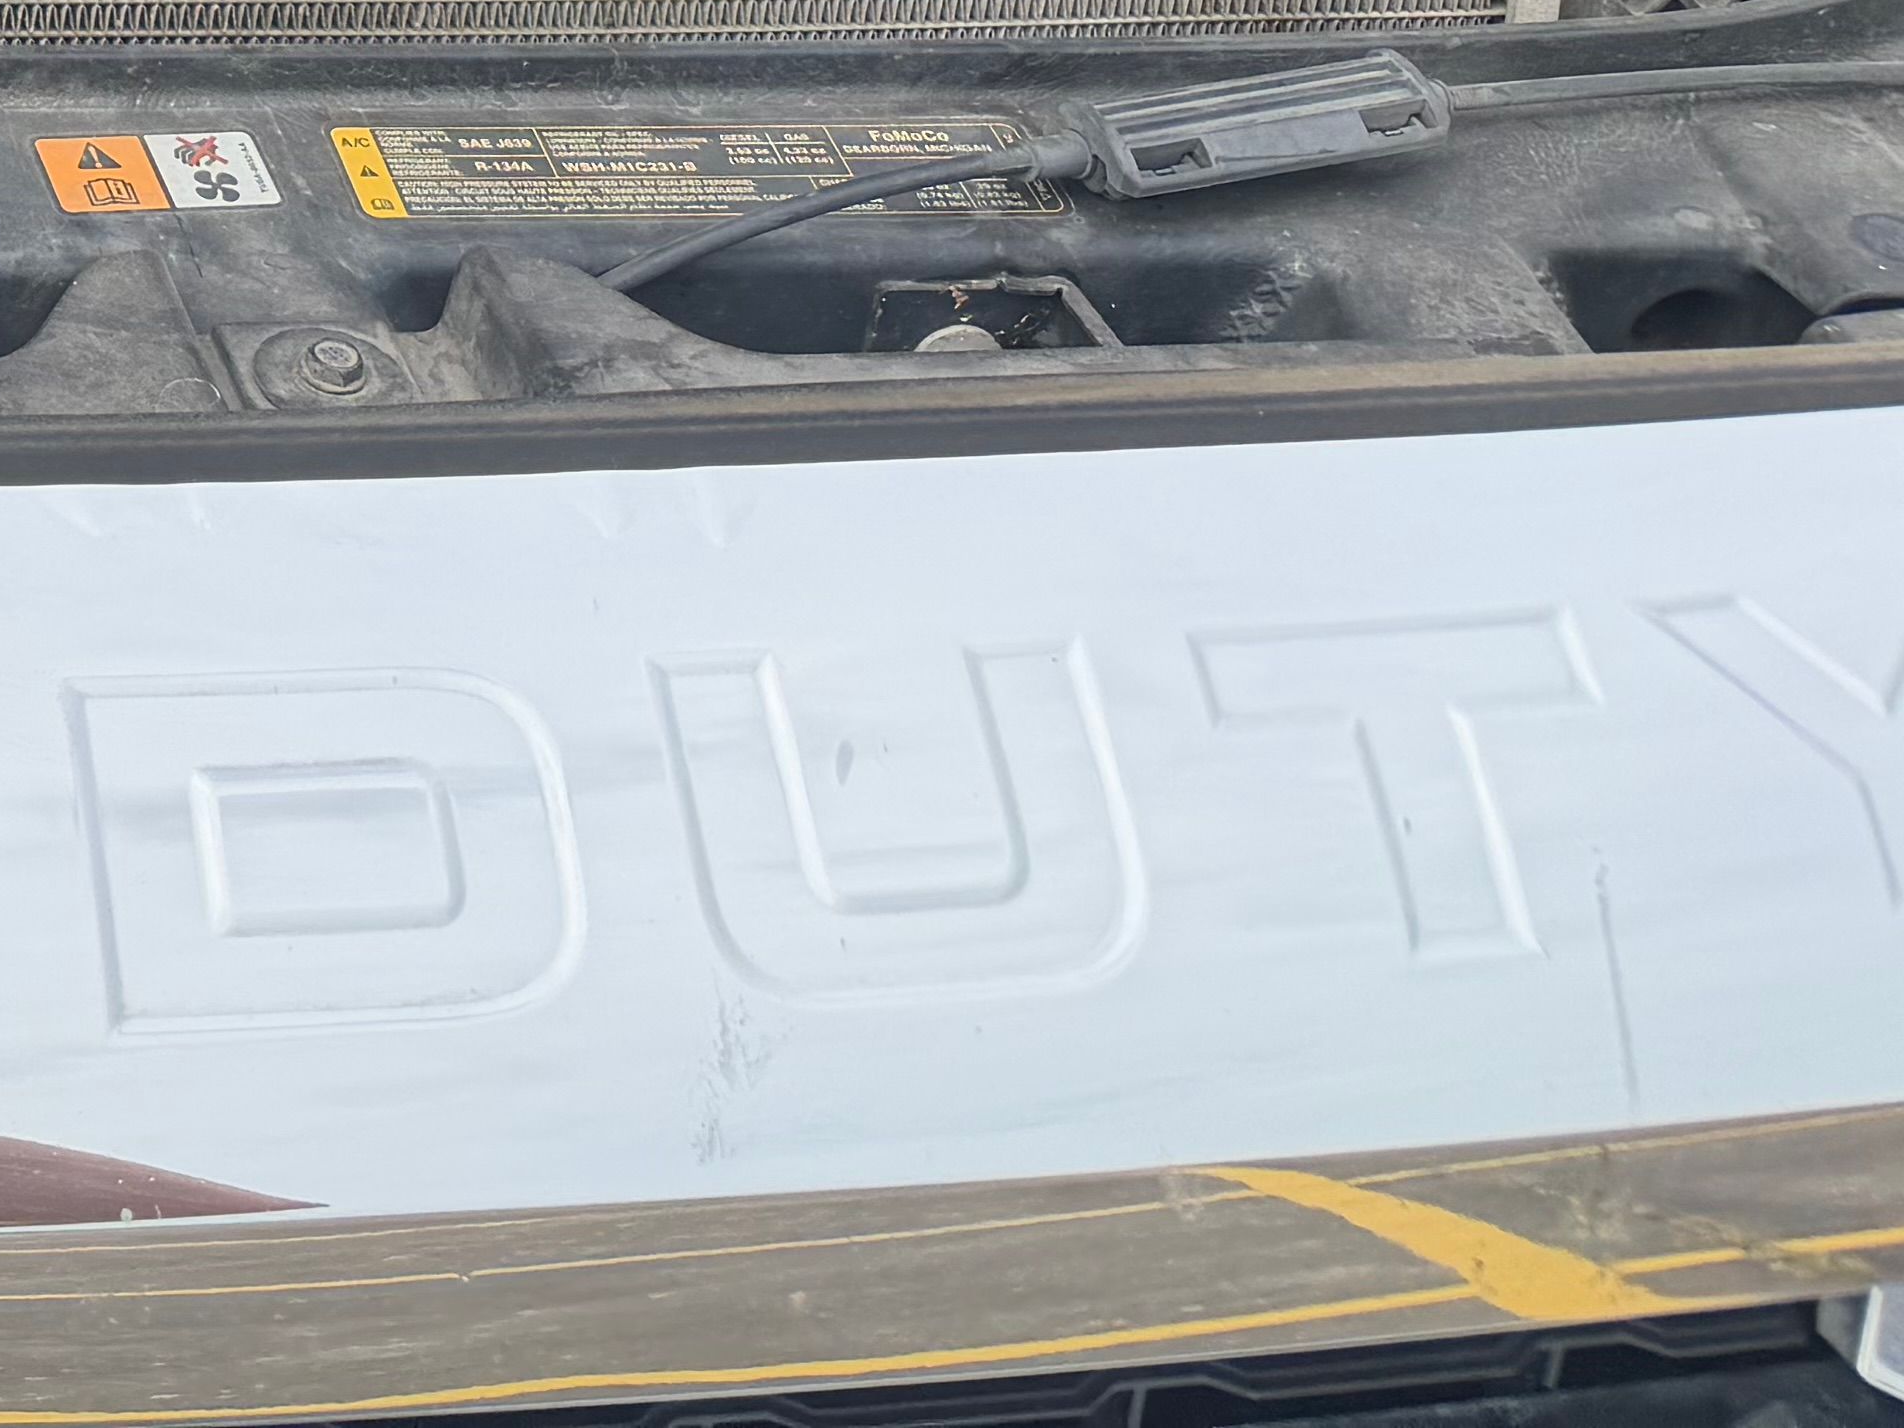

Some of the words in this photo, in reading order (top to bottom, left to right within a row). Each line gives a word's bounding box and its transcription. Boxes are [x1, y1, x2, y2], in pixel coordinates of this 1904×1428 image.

[781, 132, 811, 141] GAS
[866, 129, 951, 142] FoMoCo
[338, 136, 372, 148] A/C
[456, 138, 494, 149] SAE
[472, 160, 536, 172] R-134A
